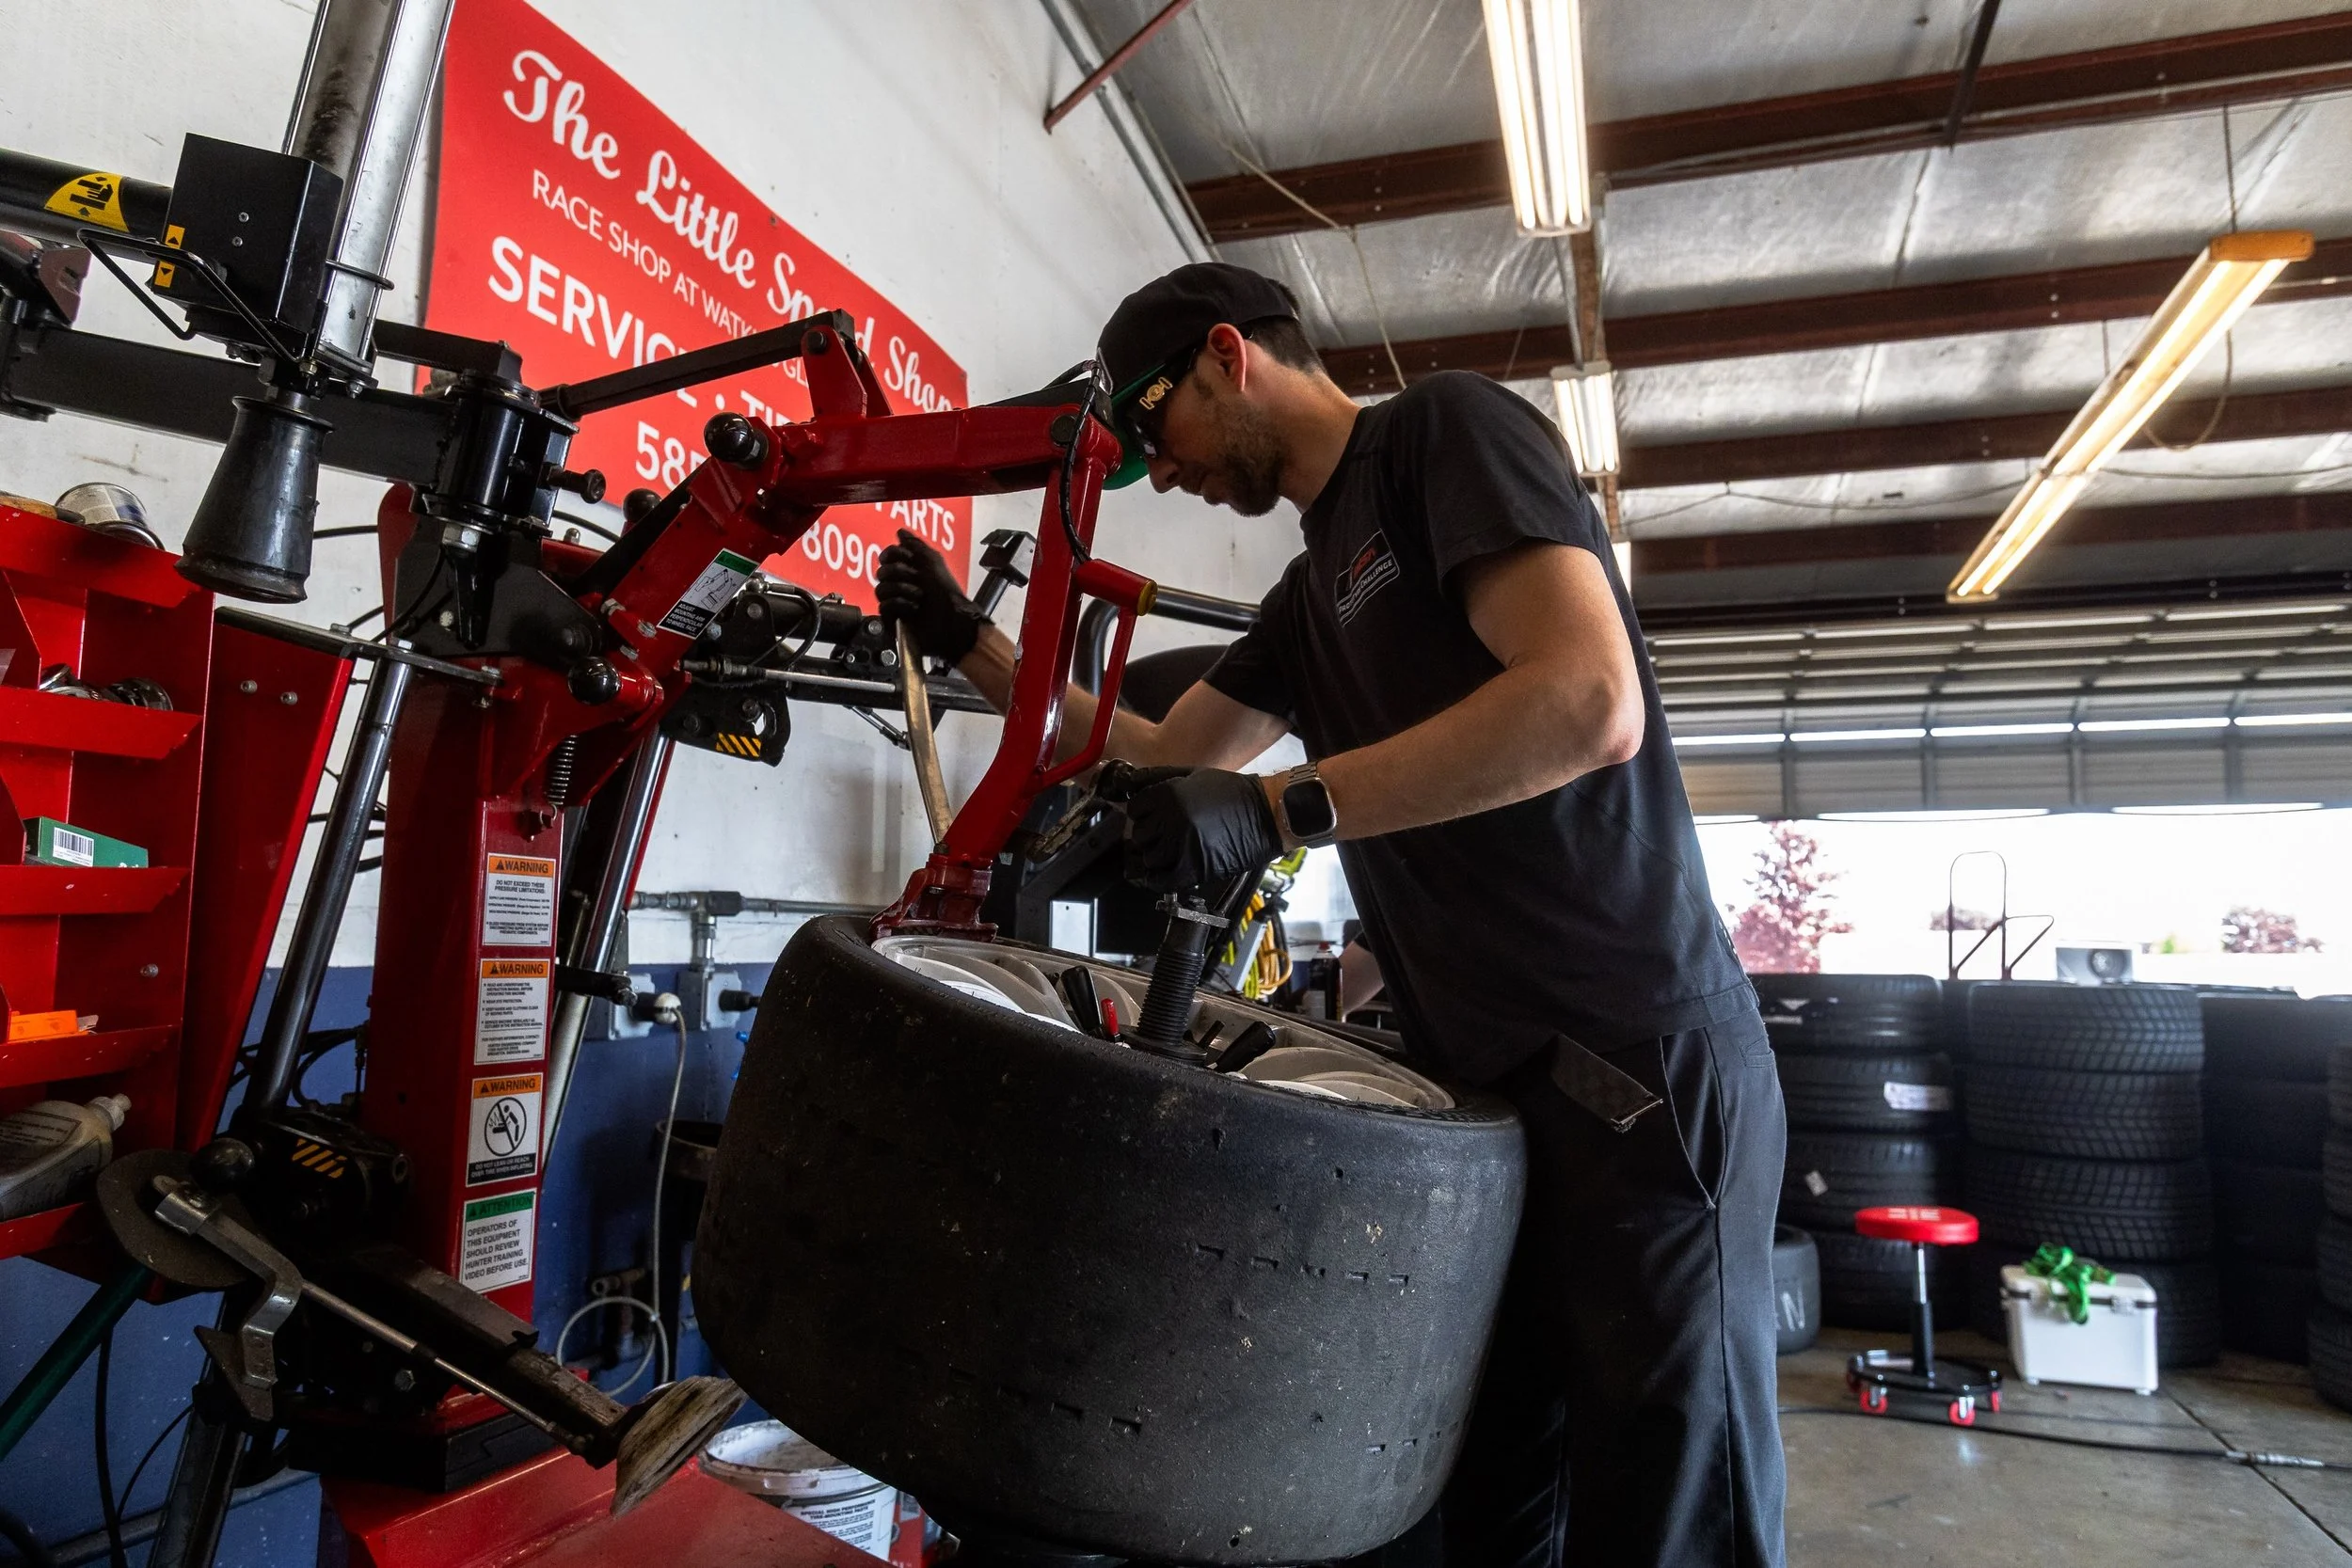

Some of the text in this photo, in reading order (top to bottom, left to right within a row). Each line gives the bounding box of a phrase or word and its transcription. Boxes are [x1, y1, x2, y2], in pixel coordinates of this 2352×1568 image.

[503, 50, 621, 180] The
[635, 150, 756, 289] Little
[767, 252, 875, 368] Spd
[532, 168, 603, 242] RACE
[608, 221, 671, 283] SHOP
[674, 272, 699, 307] AT
[875, 499, 956, 552] ARTS
[1360, 559, 1393, 589] CHALLENGE
[505, 860, 548, 874] WARNING
[500, 964, 544, 974] WARNING
[490, 1078, 535, 1091] WARNING
[480, 1196, 532, 1214] ATTENTION
[467, 1219, 517, 1237] OPERATORS OF
[467, 1228, 520, 1247] THIS EQUIPMENT
[466, 1240, 520, 1259] SHOULD REVIEW
[465, 1249, 523, 1270] HUNTER TRAINING
[465, 1269, 485, 1280] VIDEO
[485, 1261, 513, 1275] BEFORE
